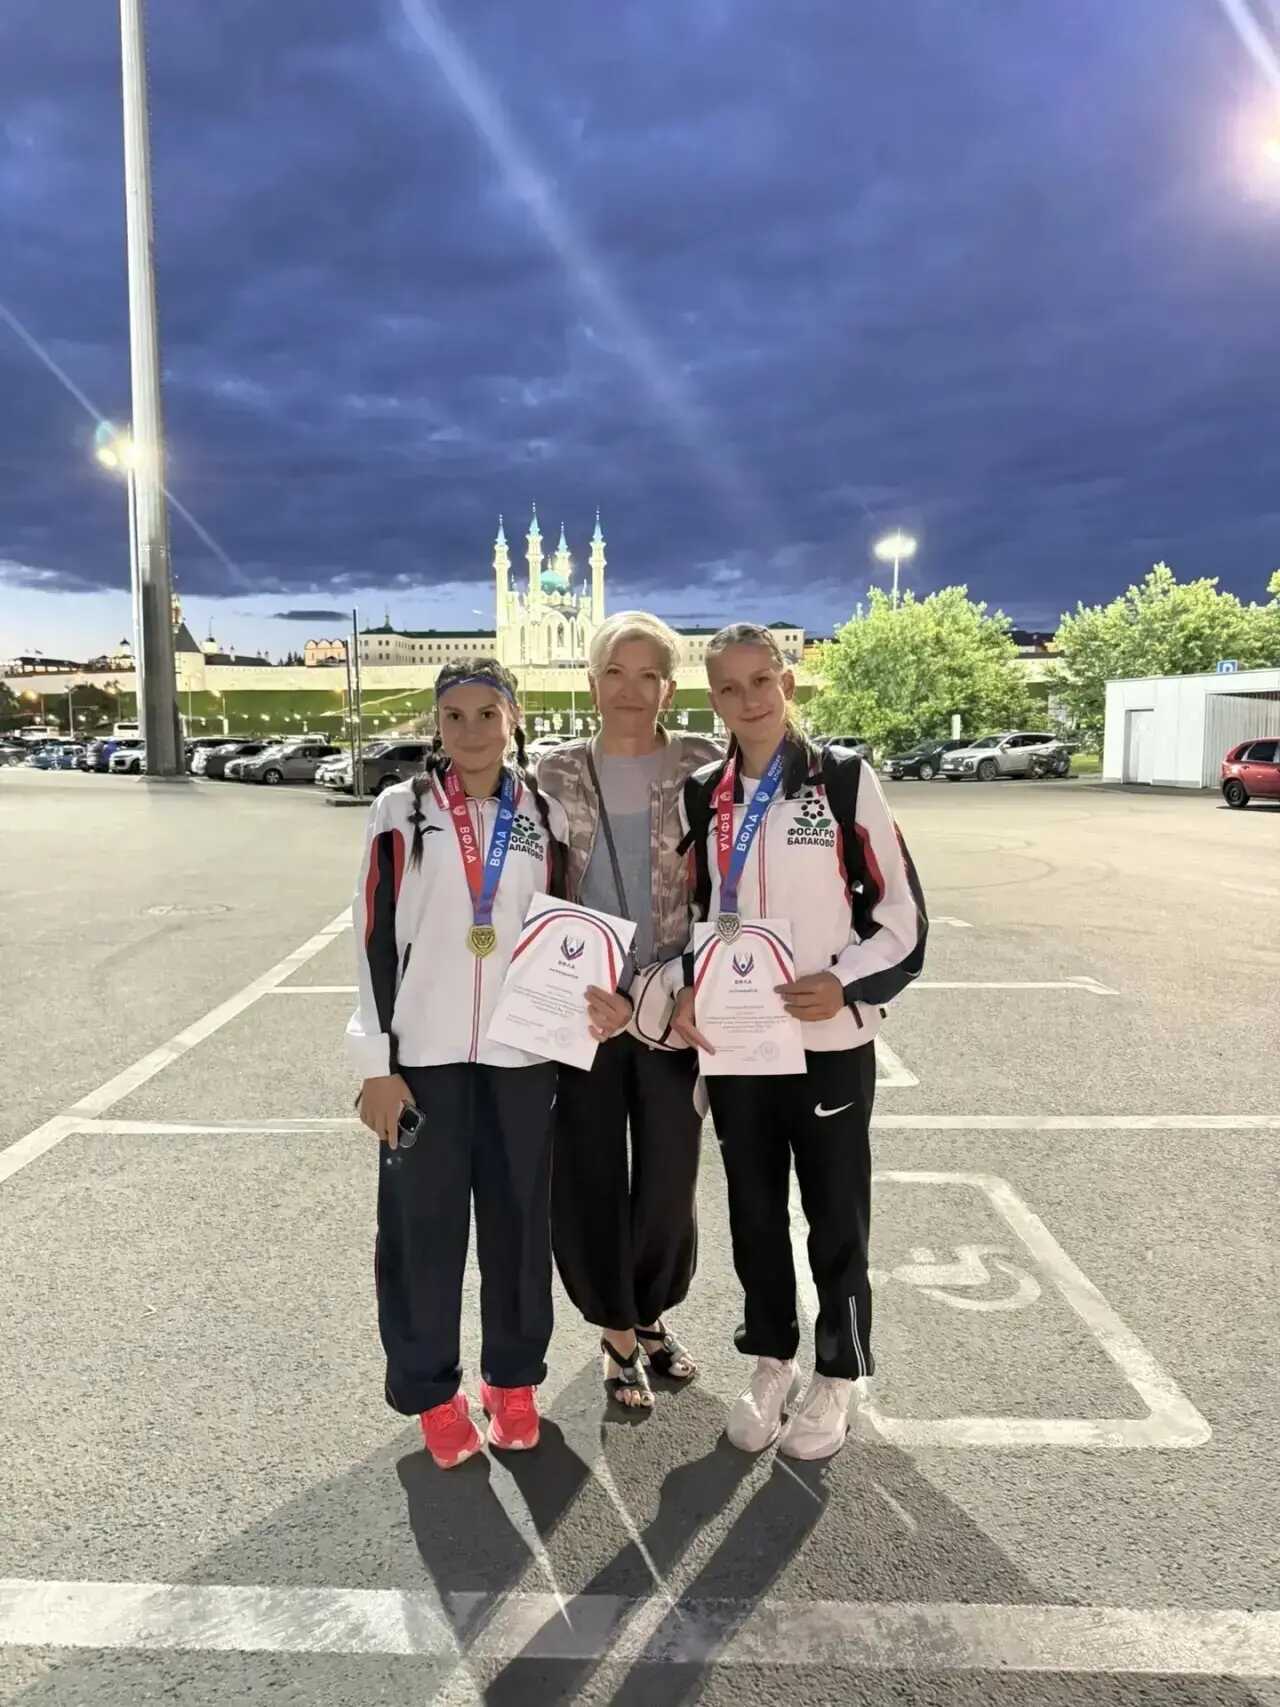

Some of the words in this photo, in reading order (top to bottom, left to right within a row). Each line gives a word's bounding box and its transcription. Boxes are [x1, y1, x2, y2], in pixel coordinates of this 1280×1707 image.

[460, 826, 478, 864] ВФЛА
[511, 835, 544, 853] ОСАГРО
[719, 813, 730, 852] ВФЛА
[736, 813, 760, 852] ВФЛА
[787, 827, 836, 839] ФОСАГРО
[787, 836, 836, 848] БАЛАКОВО
[489, 831, 508, 867] ВФЛА
[508, 842, 544, 862] АЛАКОВО
